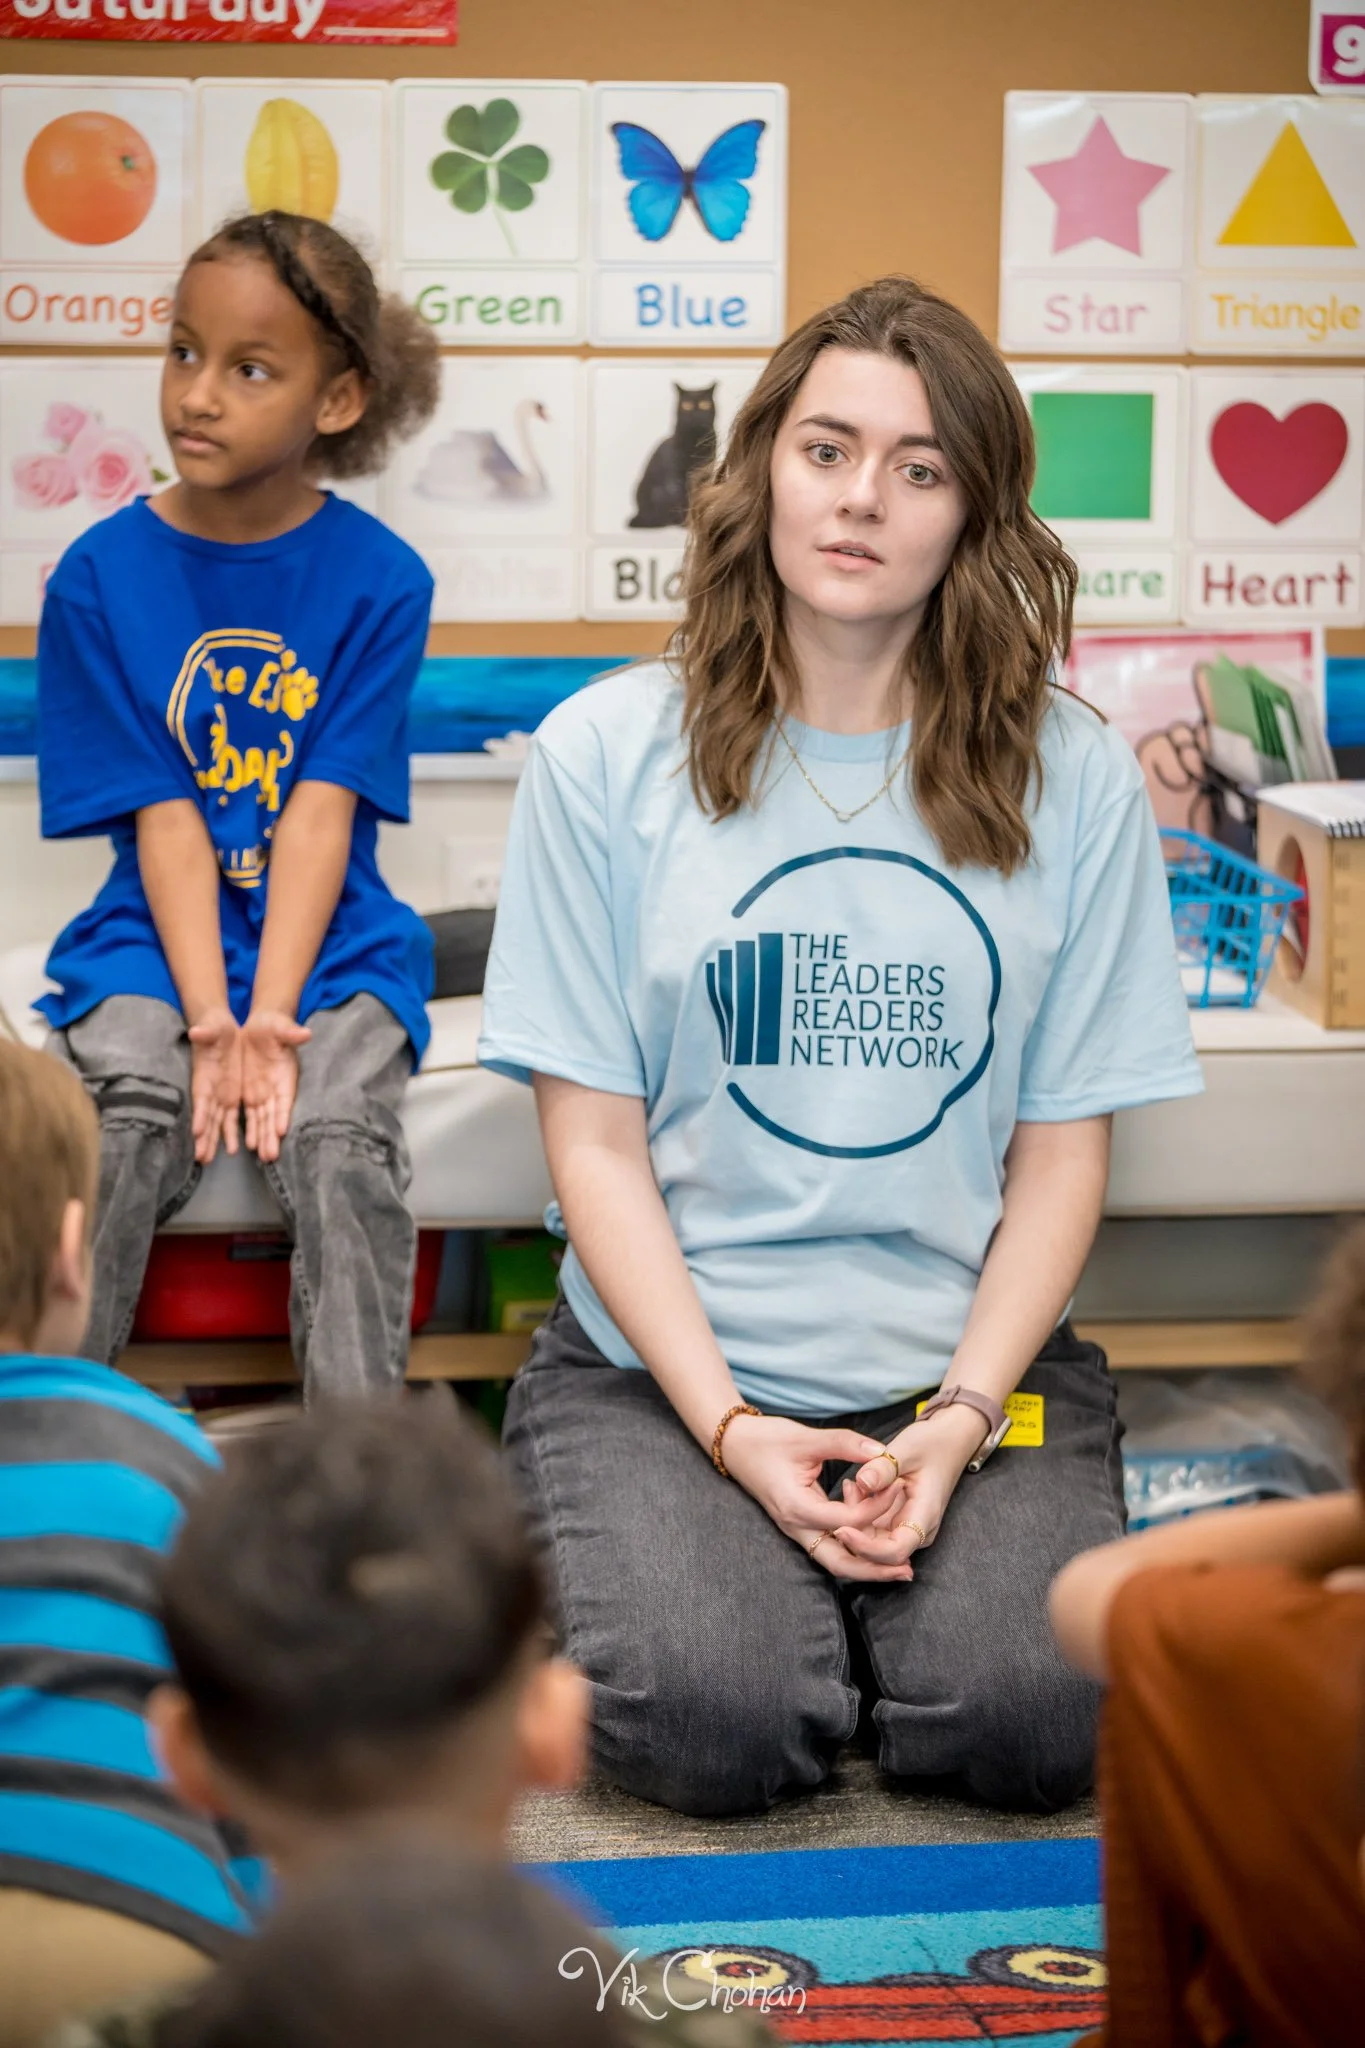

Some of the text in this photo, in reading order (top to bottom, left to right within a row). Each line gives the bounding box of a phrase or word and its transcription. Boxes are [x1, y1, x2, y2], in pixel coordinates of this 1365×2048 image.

[1332, 24, 1365, 77] 9
[4, 283, 173, 336] Orange
[415, 286, 563, 325] Green
[636, 284, 747, 328] Blue
[1044, 294, 1149, 334] Star
[1210, 294, 1361, 341] Triangle
[612, 557, 688, 602] Bla
[1079, 569, 1164, 598] are
[1202, 561, 1353, 607] Heart
[789, 933, 848, 959] THE
[795, 963, 945, 996] LEADERS
[792, 999, 945, 1032] READERS
[790, 1035, 964, 1070] NETWORK
